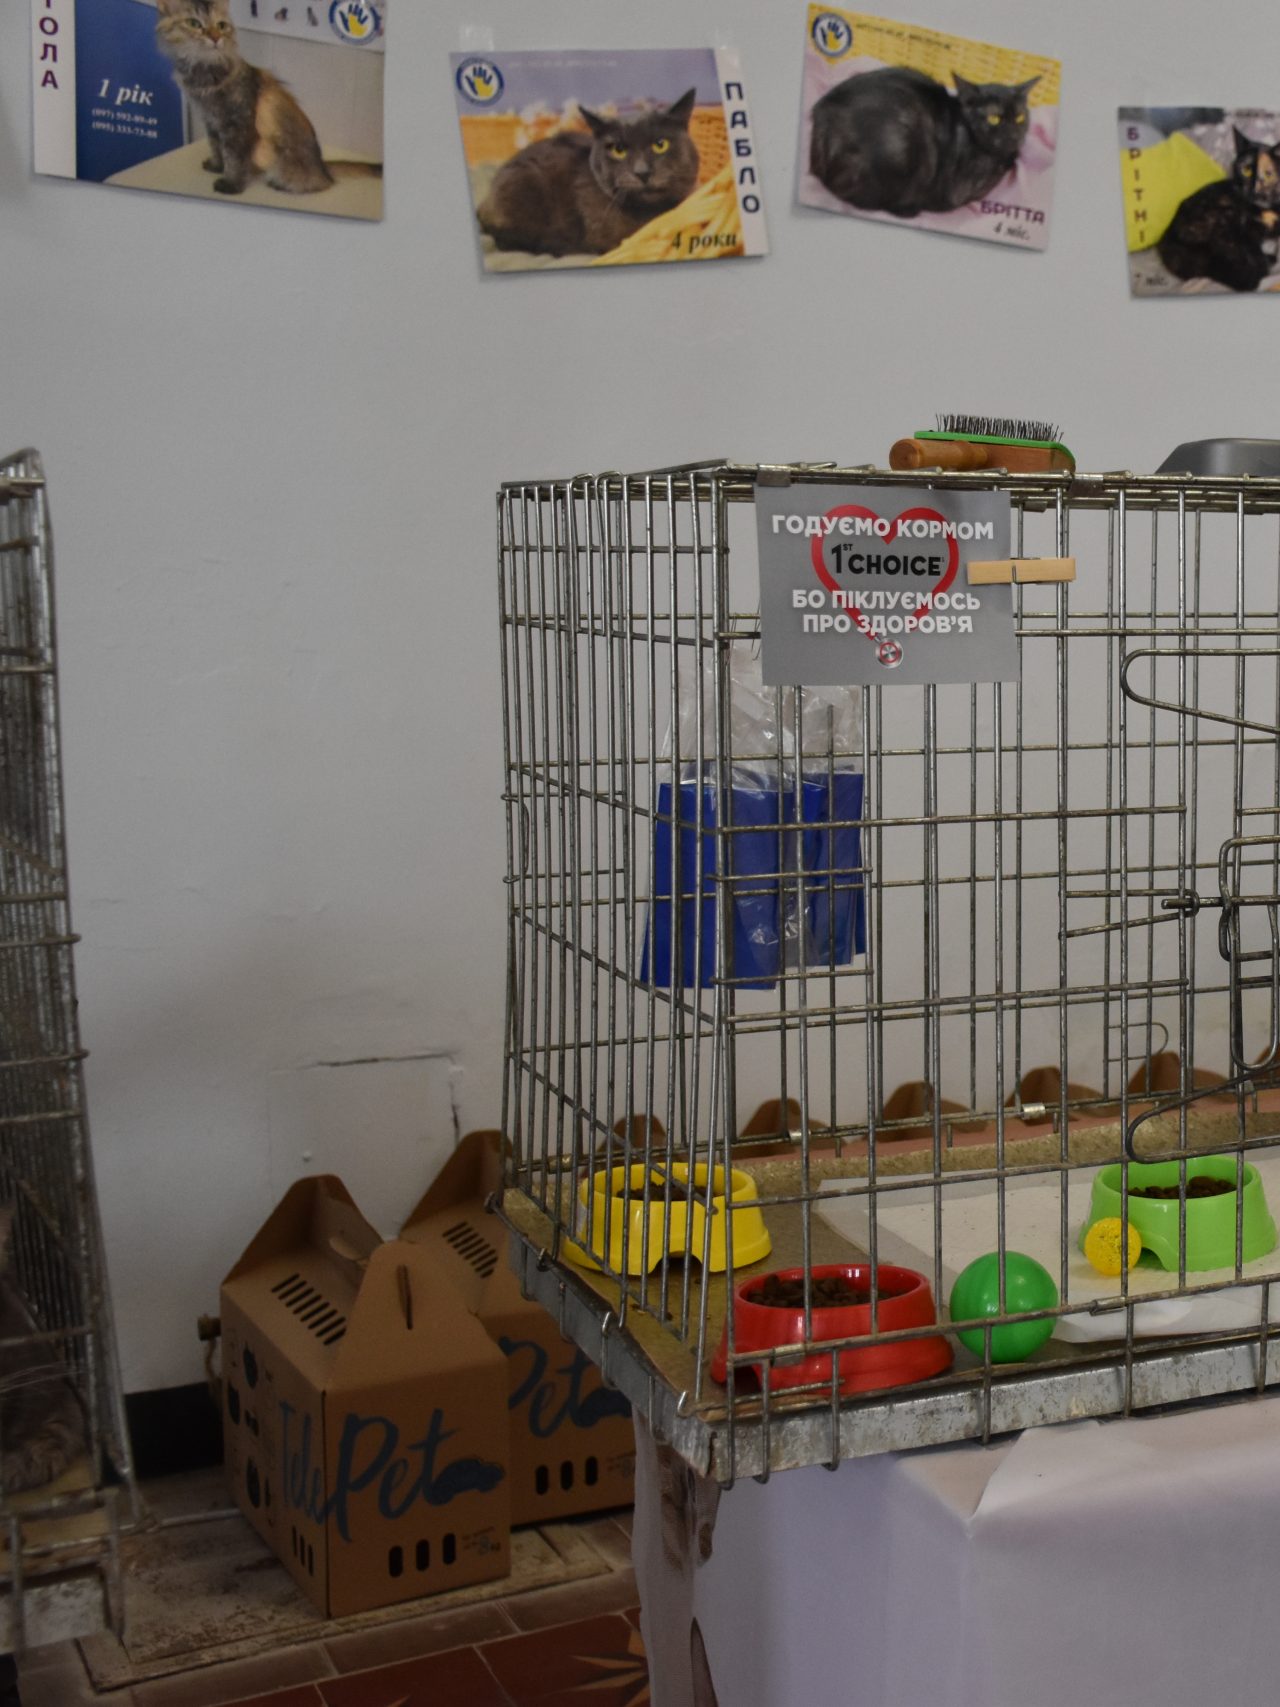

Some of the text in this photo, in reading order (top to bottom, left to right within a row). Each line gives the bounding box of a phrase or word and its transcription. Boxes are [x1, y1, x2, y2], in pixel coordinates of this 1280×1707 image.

[99, 79, 154, 106] 1 рік
[724, 81, 761, 214] ПАБЛО
[1126, 126, 1148, 244] БРІТНІ
[980, 200, 1046, 225] БРІТТА
[670, 230, 738, 250] 4 роки
[771, 514, 995, 540] ГОДУЄМО КОРМОМ
[847, 554, 942, 577] CHOICE
[792, 589, 981, 610] БО ПІКЛУЄМОСЬ
[803, 614, 852, 633] ПРО
